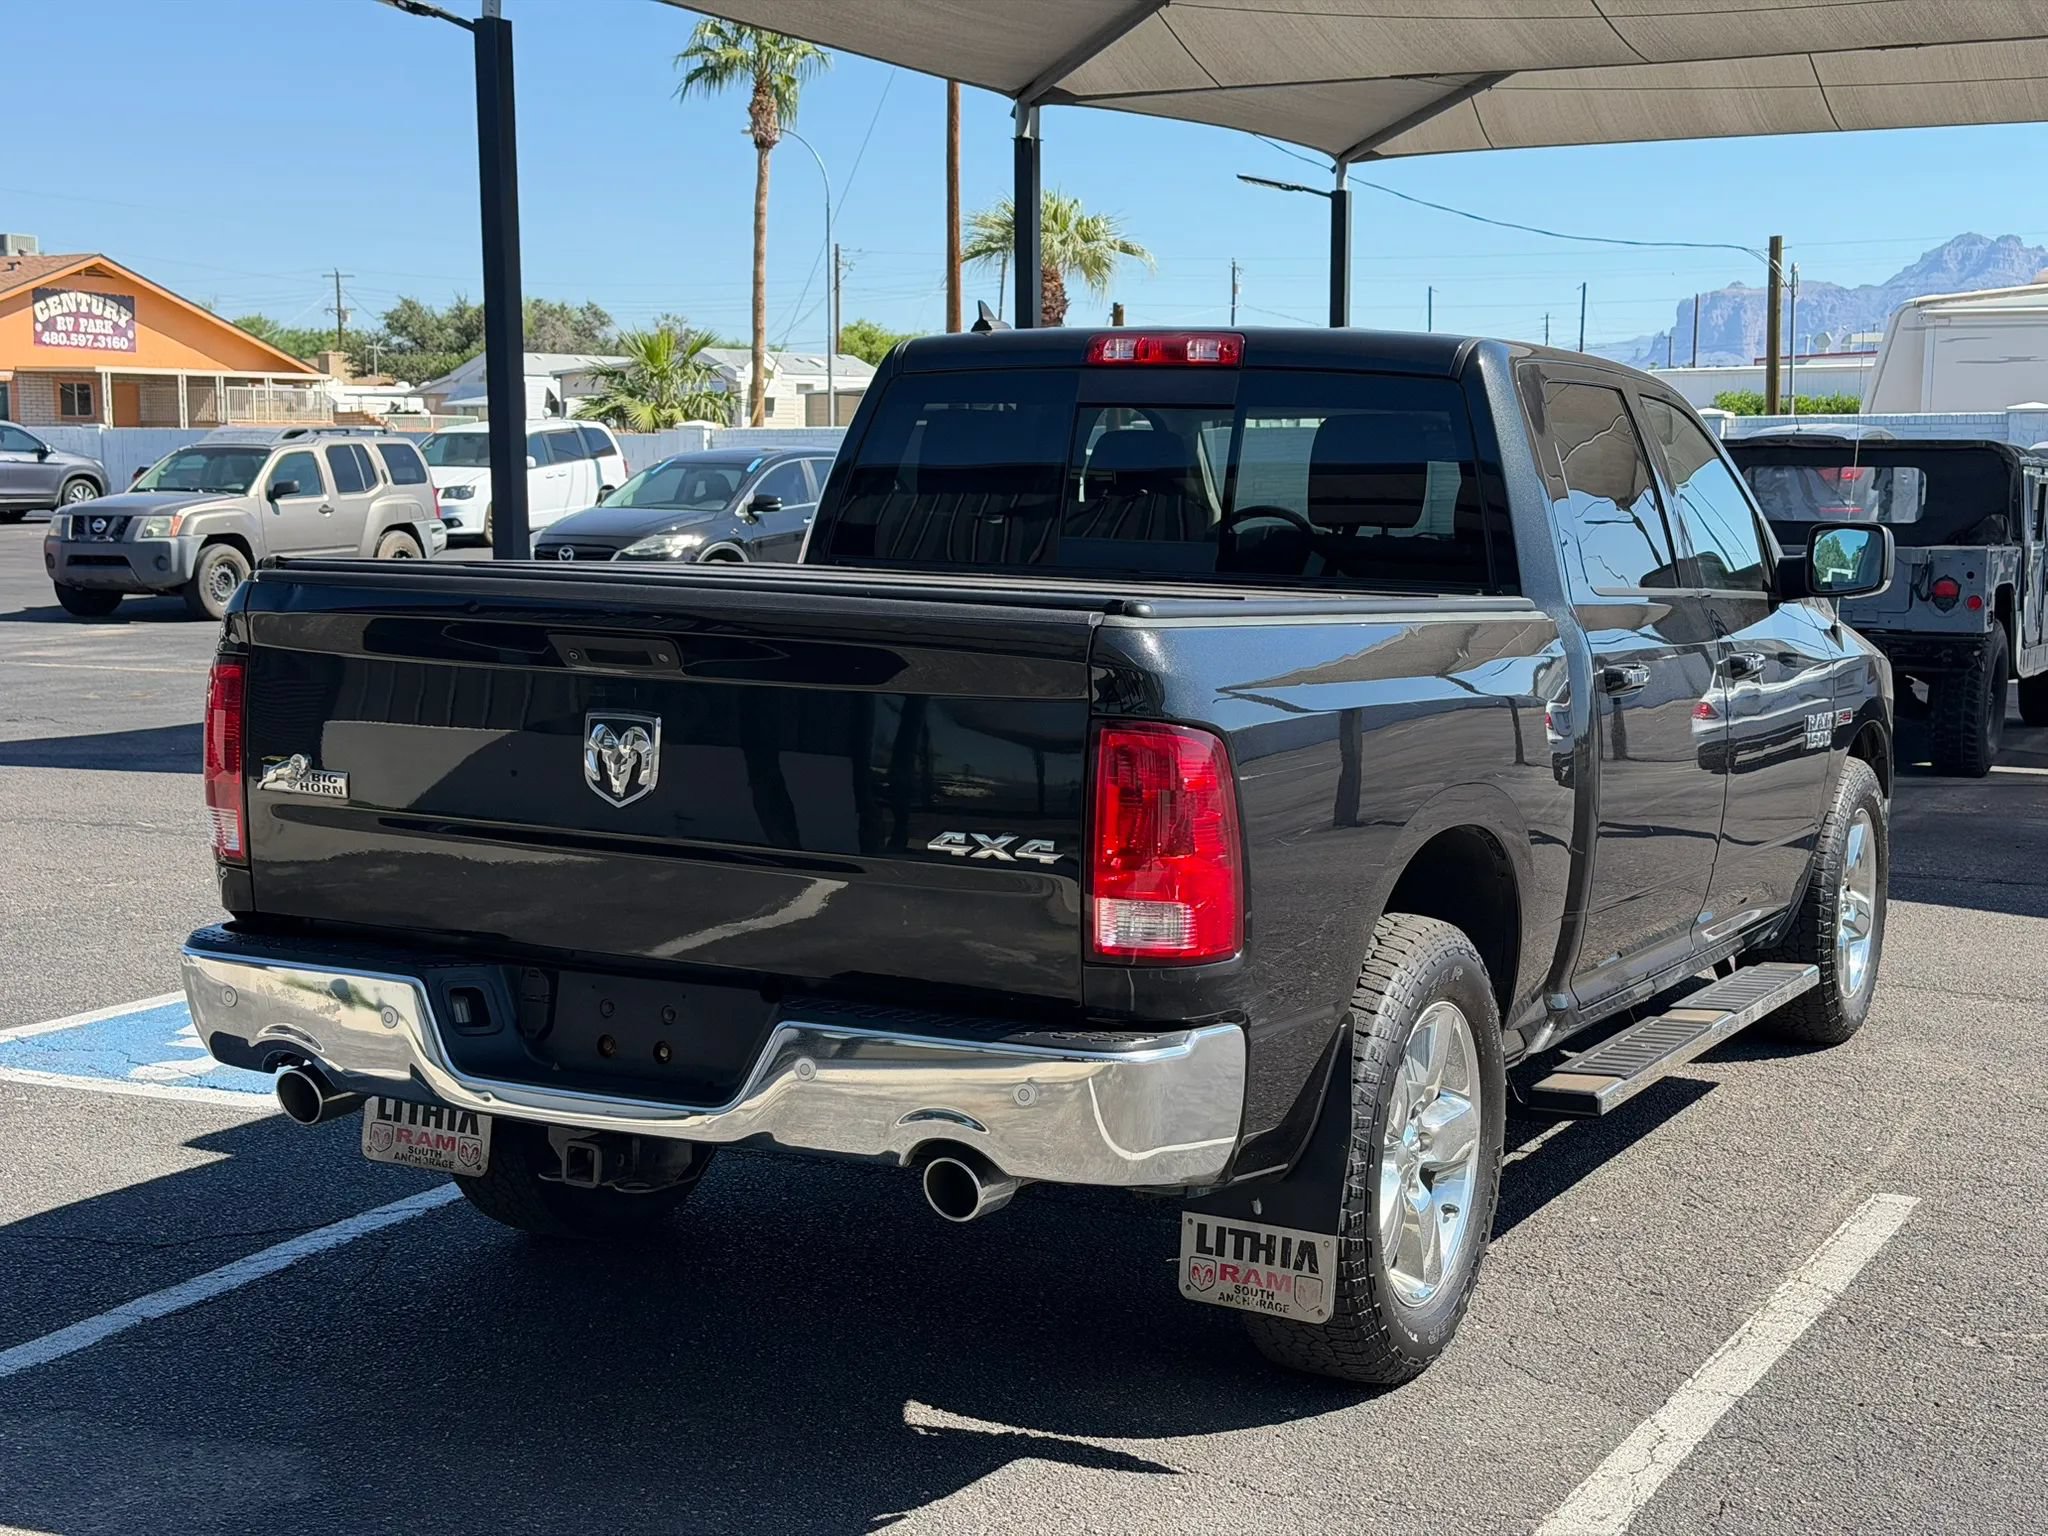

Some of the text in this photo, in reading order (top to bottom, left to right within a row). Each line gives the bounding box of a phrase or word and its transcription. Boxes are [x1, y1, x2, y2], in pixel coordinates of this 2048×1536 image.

[34, 292, 133, 328] CENTURY
[56, 316, 113, 334] RV PARK
[41, 331, 129, 349] 480.597.3160
[1807, 712, 1834, 731] RAM
[311, 772, 338, 784] BIG
[300, 782, 344, 795] HORN
[377, 1097, 480, 1136] LITHIA
[394, 1127, 457, 1152] RAM
[394, 1151, 456, 1169] ANCHORAGE
[408, 1145, 442, 1159] SOUTH
[1196, 1222, 1320, 1275] LITHIA
[1219, 1263, 1293, 1293] RAM
[1234, 1284, 1276, 1300] SOUTH
